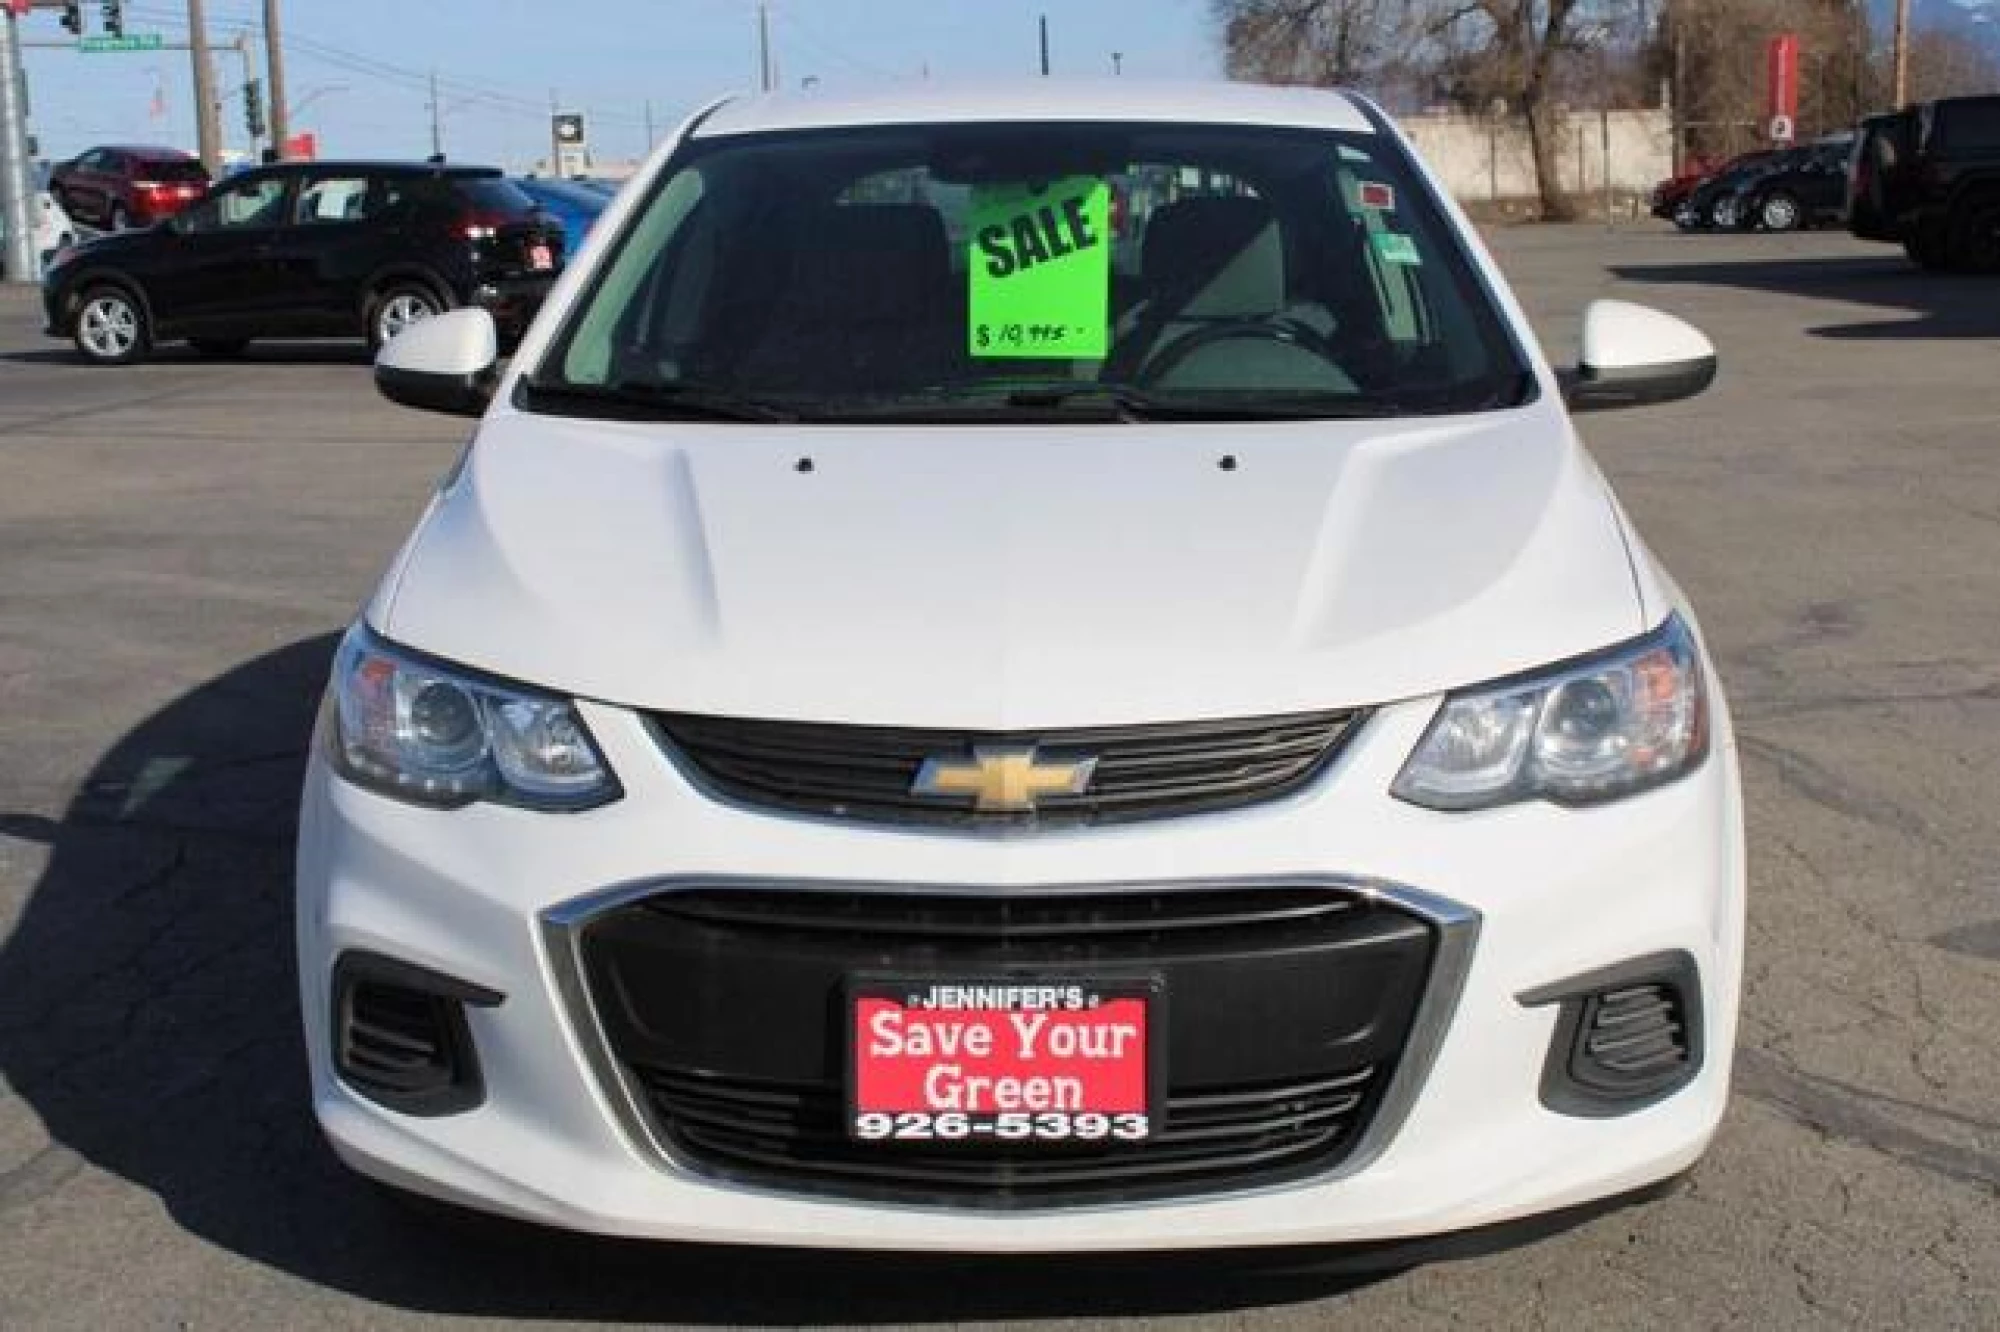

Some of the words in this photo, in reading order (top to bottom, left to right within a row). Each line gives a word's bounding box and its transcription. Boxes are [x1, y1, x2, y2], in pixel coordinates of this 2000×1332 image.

[979, 197, 1098, 278] SALE
[922, 986, 1084, 1009] JENNIFER'S
[869, 1010, 993, 1057] Save
[1010, 1013, 1137, 1058] Your
[923, 1064, 1084, 1109] Green
[856, 1112, 1149, 1139] 926-5393
